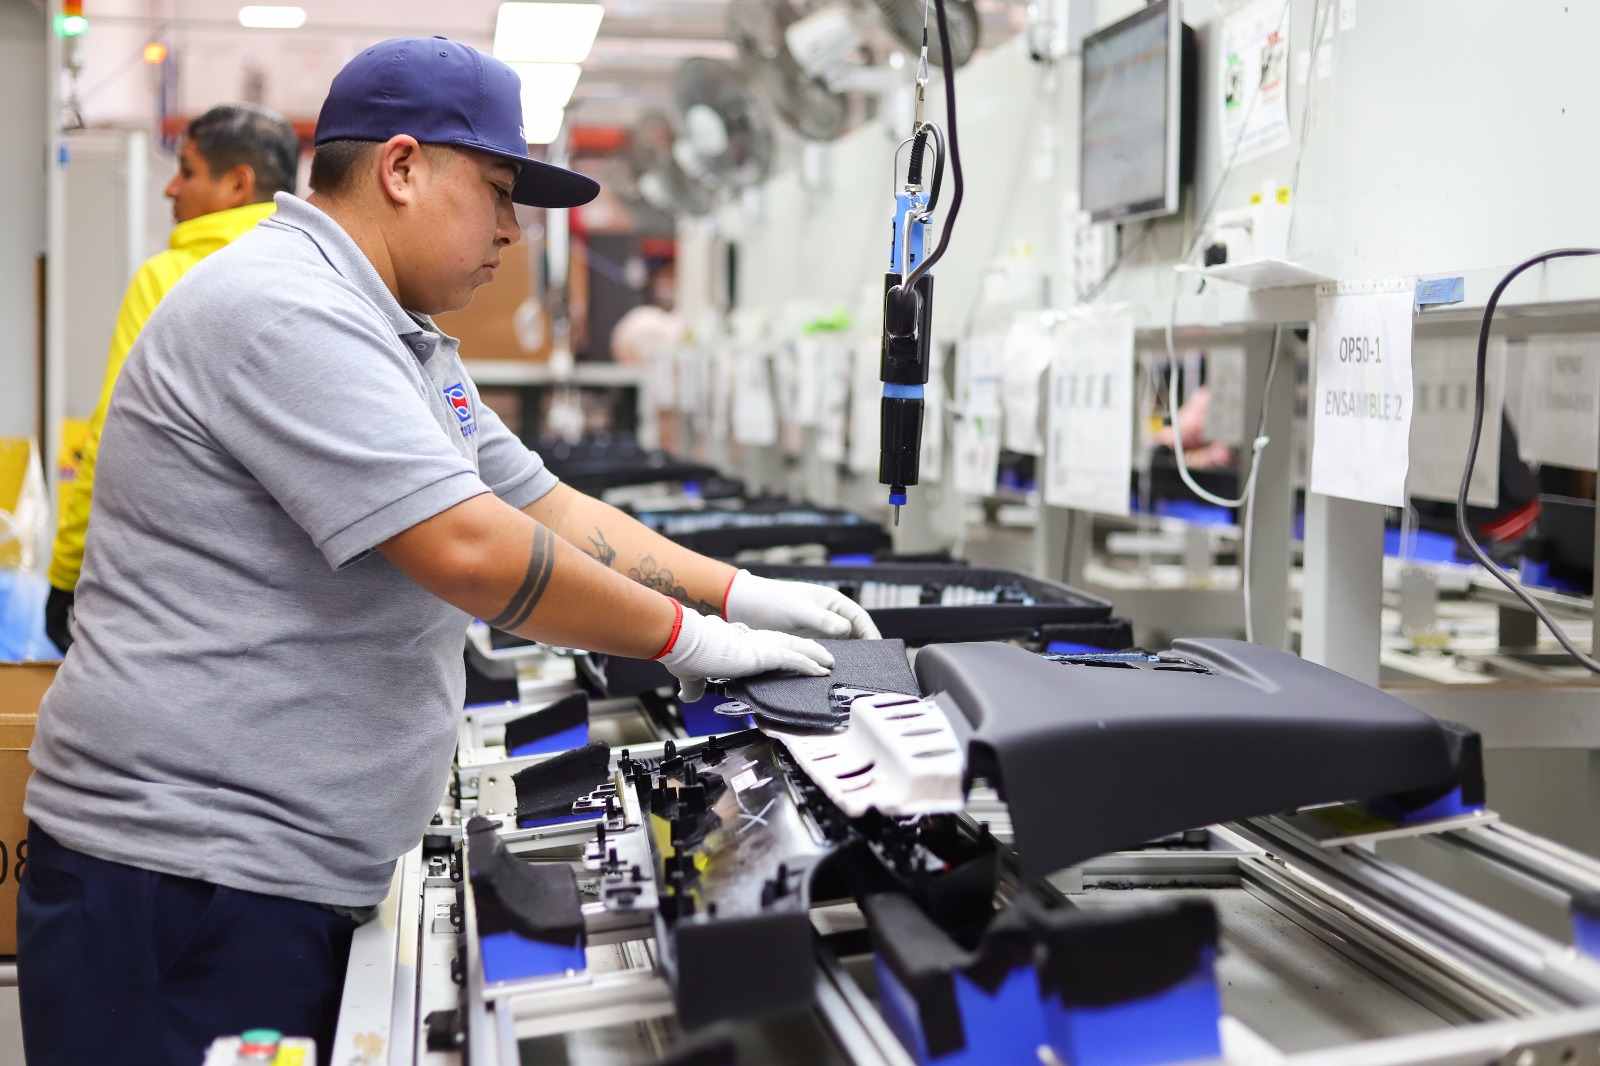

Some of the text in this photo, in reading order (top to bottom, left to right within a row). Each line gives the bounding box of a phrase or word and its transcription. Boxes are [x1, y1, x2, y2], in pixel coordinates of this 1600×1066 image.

[1339, 336, 1381, 363] OP50-1
[1325, 390, 1402, 421] ENSAMBLE 2
